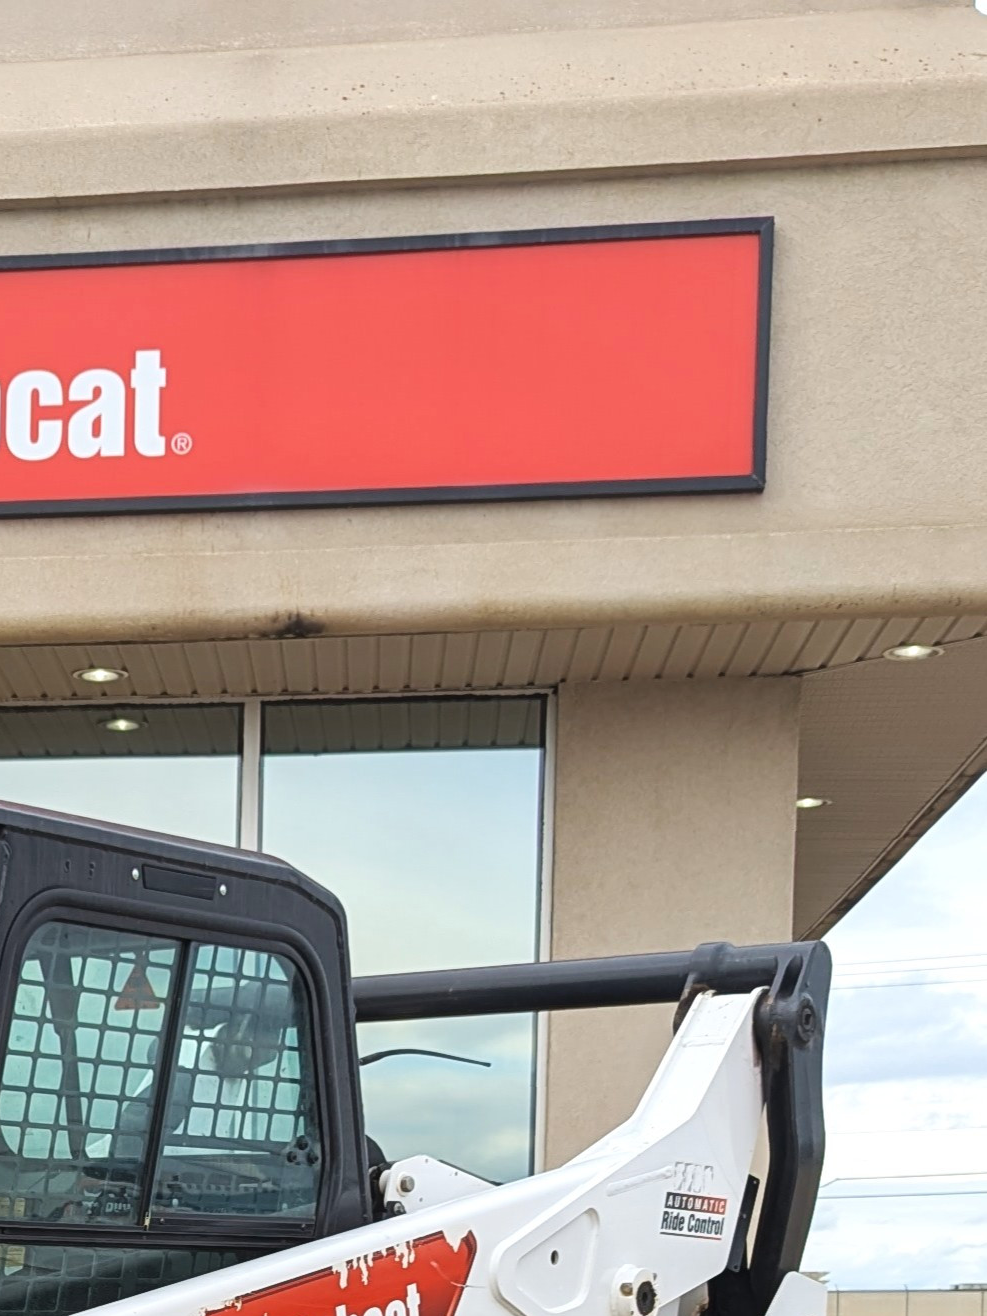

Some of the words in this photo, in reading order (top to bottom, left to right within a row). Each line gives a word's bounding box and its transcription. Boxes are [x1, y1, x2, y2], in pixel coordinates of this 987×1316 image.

[666, 1194, 726, 1213] AUTOMATIC
[660, 1210, 685, 1232] Ride
[687, 1213, 725, 1236] Control
